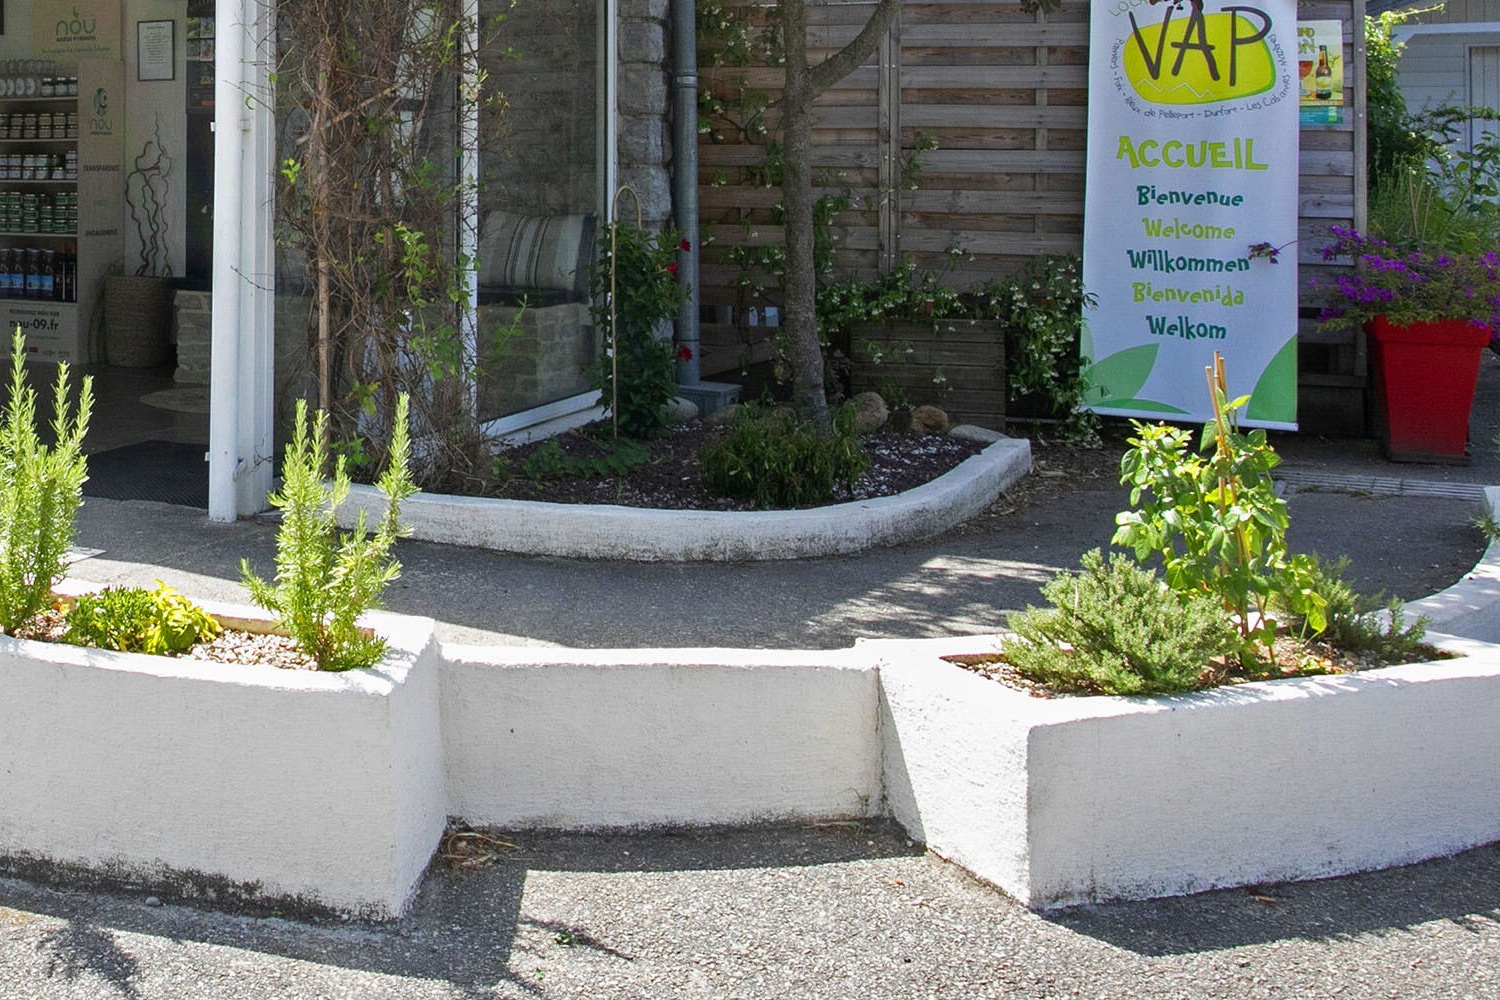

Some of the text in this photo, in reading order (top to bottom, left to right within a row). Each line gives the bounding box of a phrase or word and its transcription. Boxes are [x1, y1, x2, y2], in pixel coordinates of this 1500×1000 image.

[1129, 0, 1273, 87] VAP
[1245, 102, 1262, 112] Les
[1116, 135, 1268, 170] ACCUEIL
[1136, 185, 1244, 206] Bienvenue
[1142, 218, 1235, 240] Welcome
[1127, 250, 1250, 273] Willkommen
[1132, 282, 1244, 306] Bienvenida
[1146, 315, 1227, 340] Welkom
